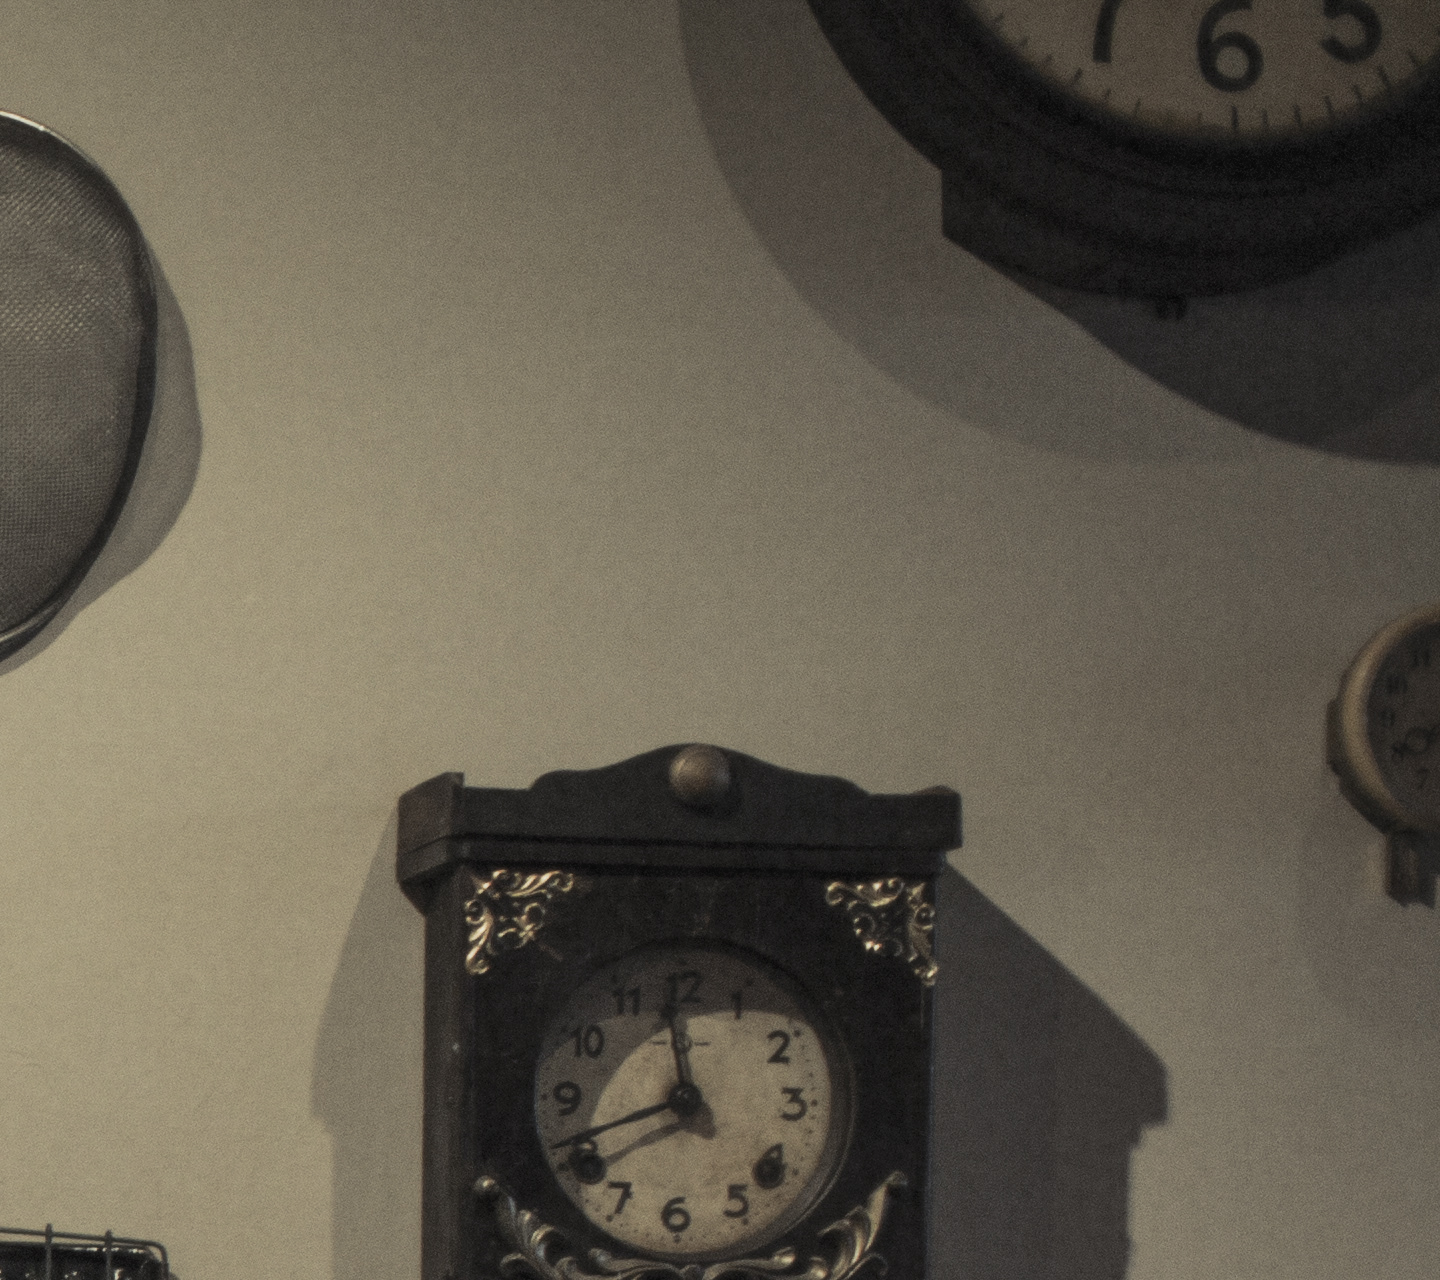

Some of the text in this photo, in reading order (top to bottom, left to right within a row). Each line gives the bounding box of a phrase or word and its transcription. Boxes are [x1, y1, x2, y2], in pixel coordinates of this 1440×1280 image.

[1197, 0, 1264, 92] 6
[612, 986, 640, 1017] 11
[667, 971, 702, 1003] 12
[731, 991, 743, 1019] 1
[570, 1024, 605, 1058] 10
[767, 1030, 790, 1063] 2
[553, 1081, 581, 1117] 9
[780, 1087, 807, 1121] 3
[608, 1182, 634, 1214] 7
[724, 1185, 749, 1218] 5
[661, 1198, 690, 1233] 6
